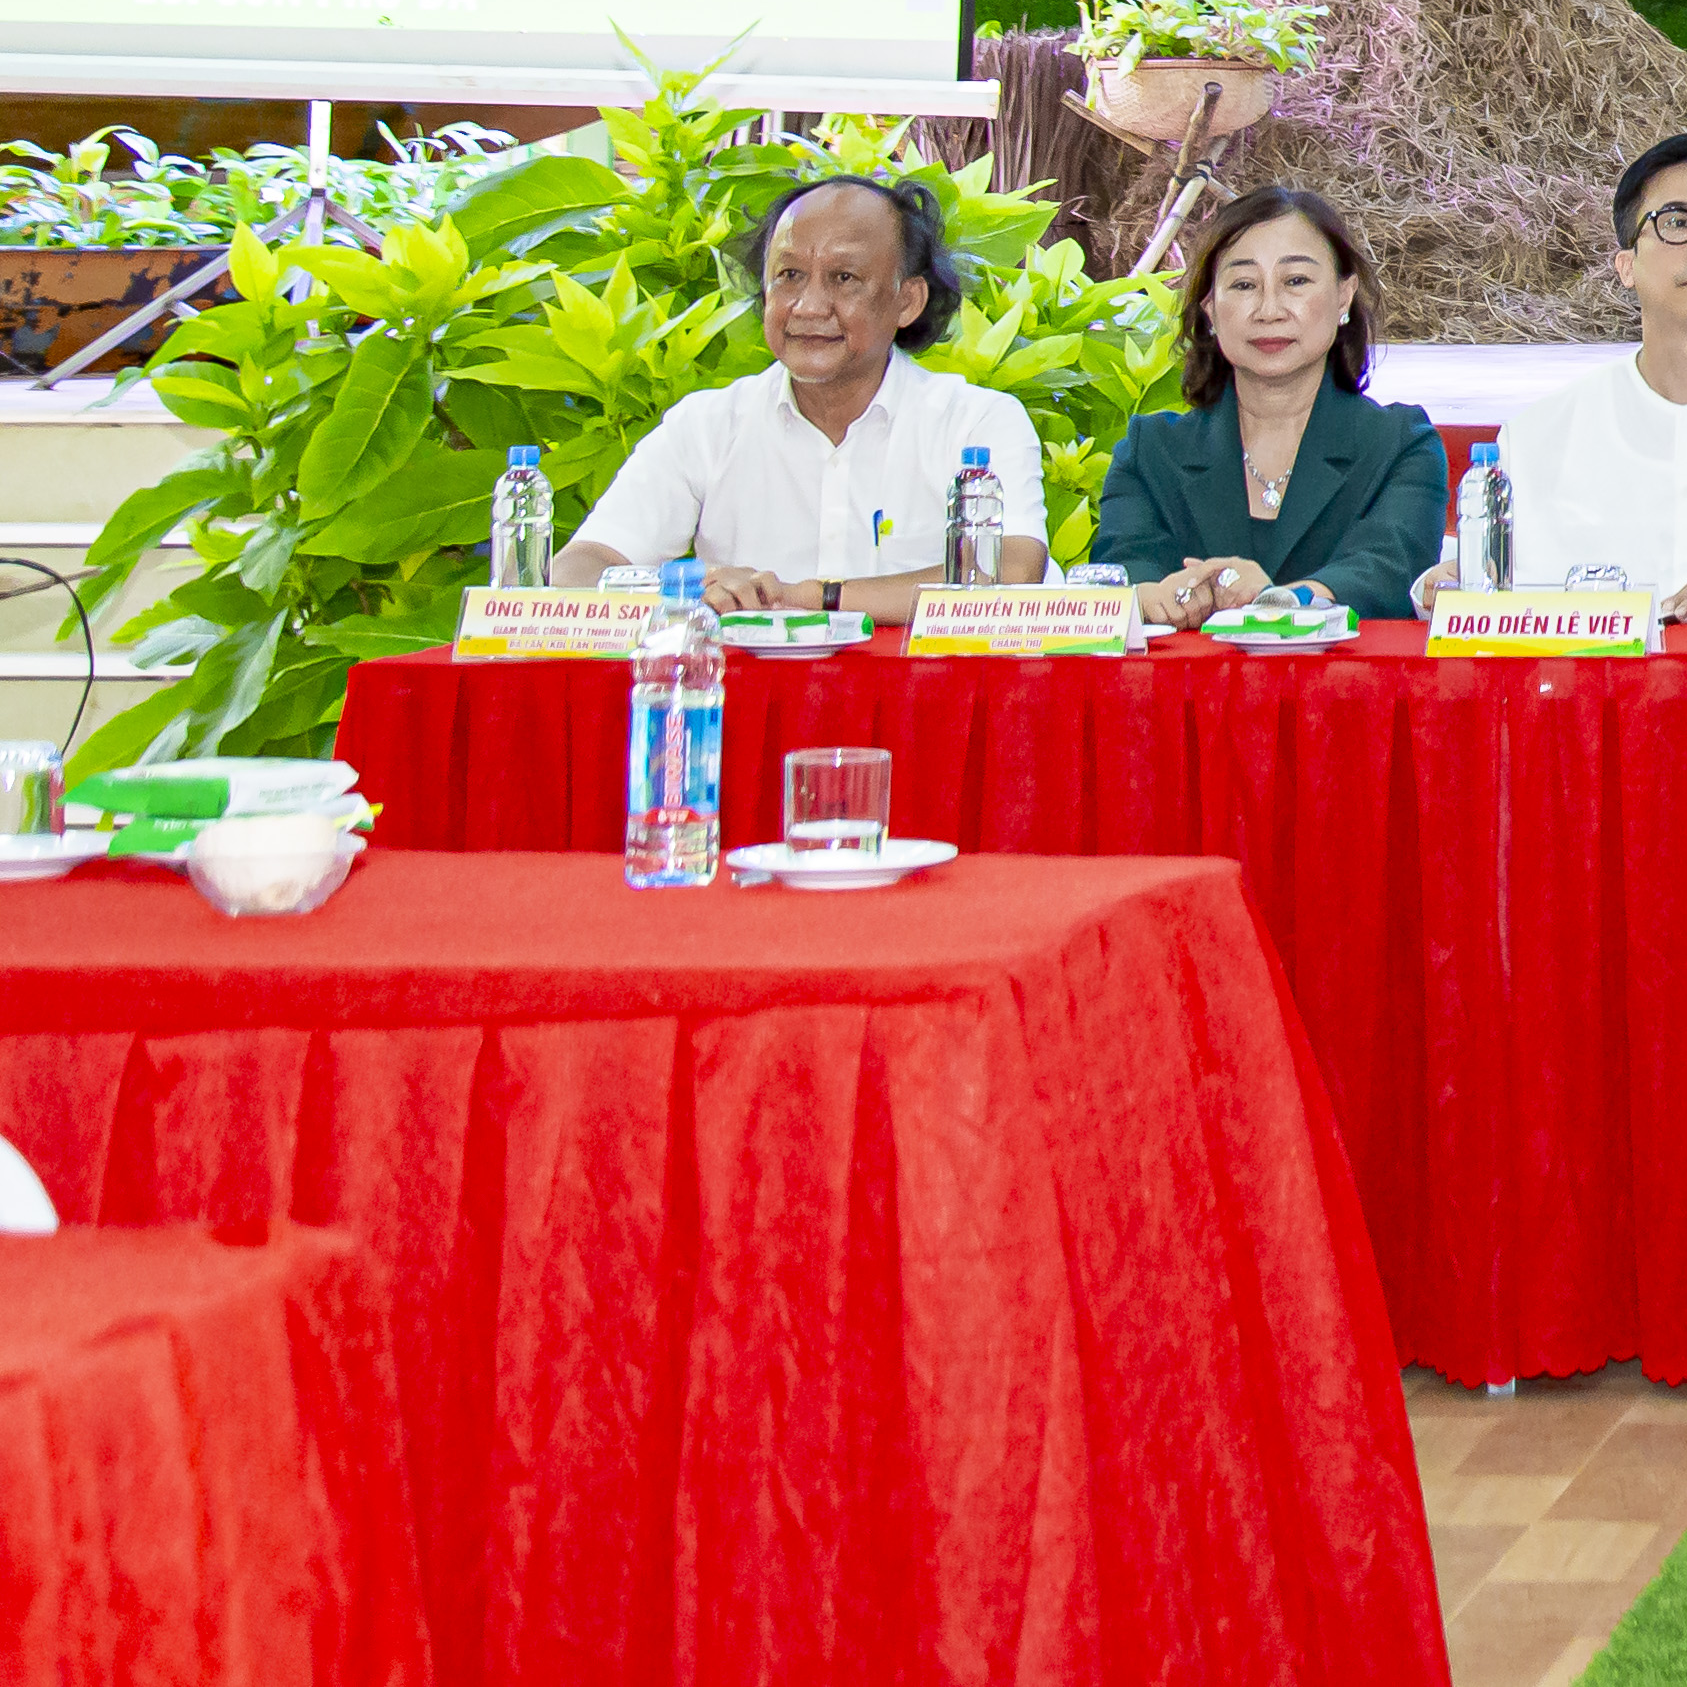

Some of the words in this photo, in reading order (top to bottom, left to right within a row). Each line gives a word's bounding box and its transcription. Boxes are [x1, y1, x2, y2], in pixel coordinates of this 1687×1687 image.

[485, 597, 524, 618] ÔNG
[1093, 600, 1122, 617] THU
[1447, 615, 1491, 640] ĐẠO
[1498, 607, 1550, 635] DIỄN
[1556, 610, 1580, 635] LÊ
[1588, 610, 1633, 640] VIỆT
